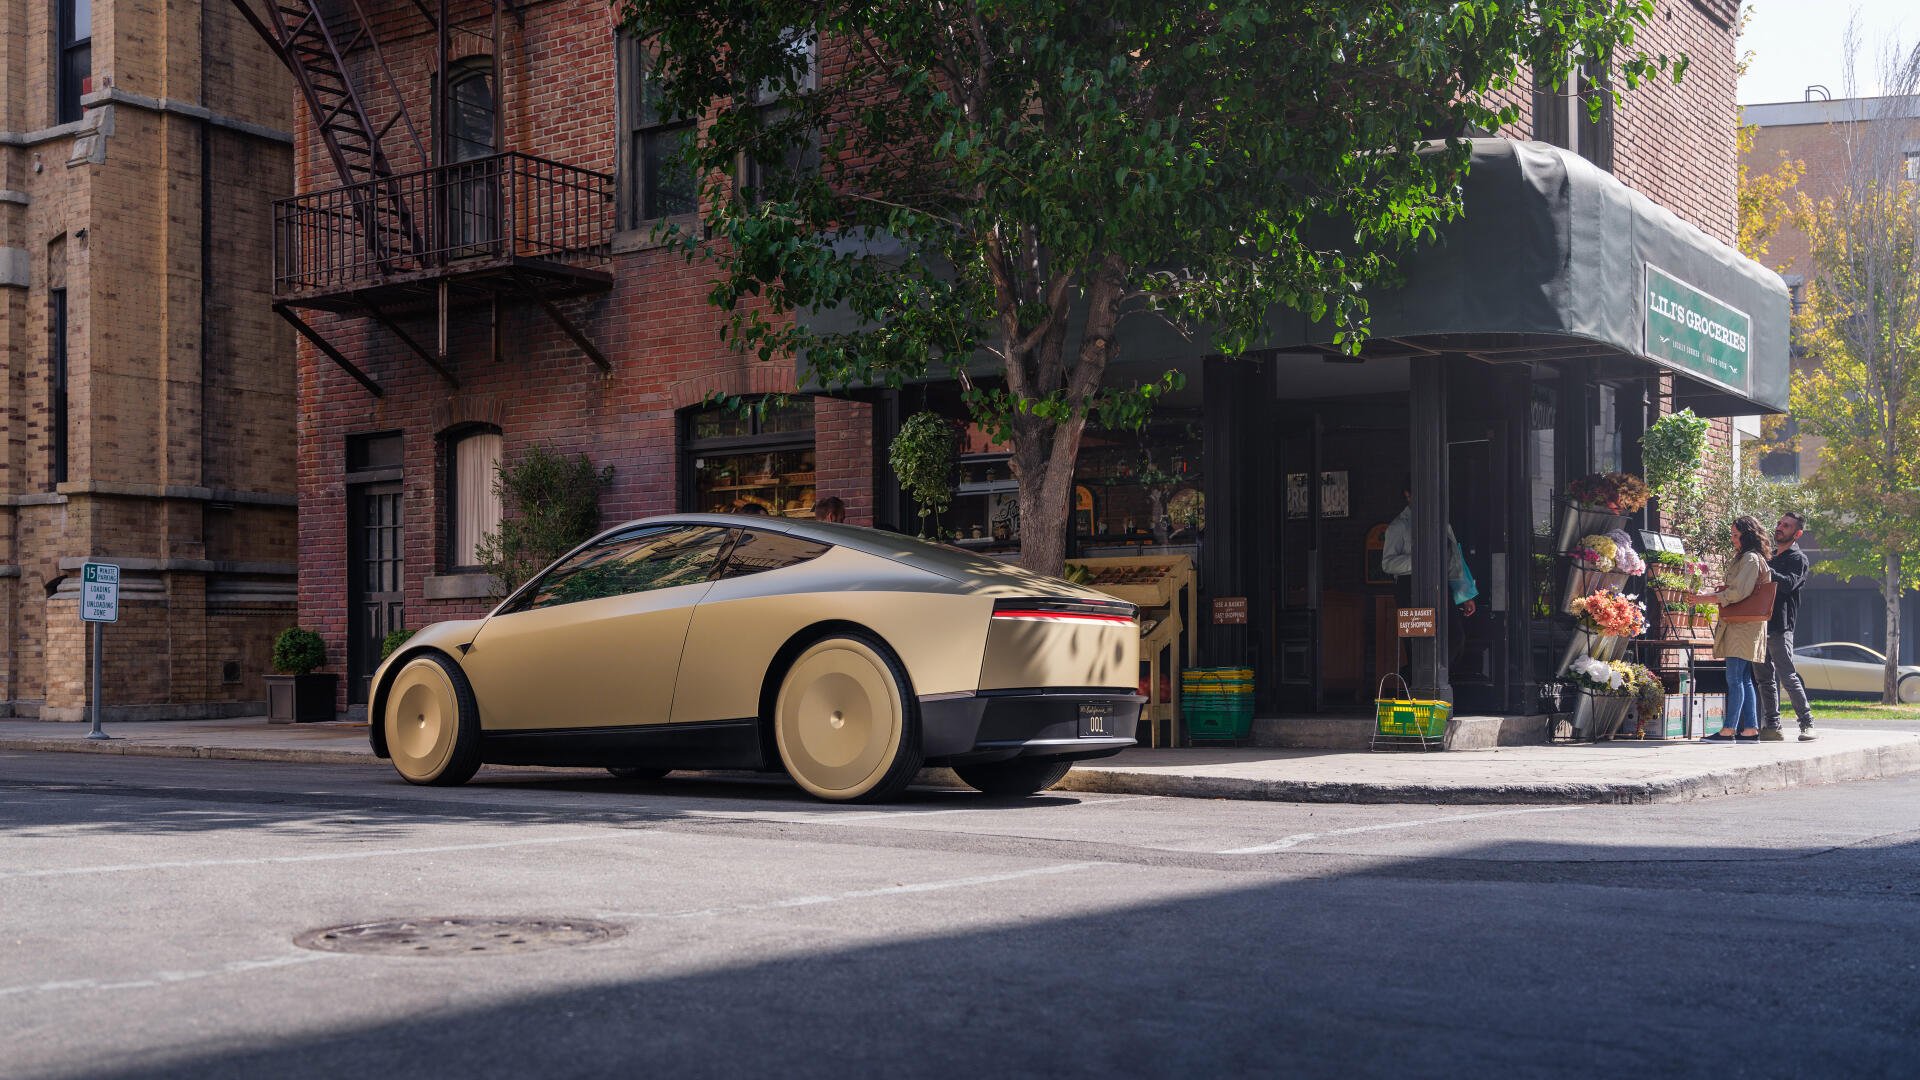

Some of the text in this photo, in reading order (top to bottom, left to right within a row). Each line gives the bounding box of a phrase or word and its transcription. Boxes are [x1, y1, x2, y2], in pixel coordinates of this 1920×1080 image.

[1650, 291, 1746, 352] LILI'S GROCERIES
[86, 567, 96, 579] 15
[97, 574, 117, 582] PARKING
[90, 585, 111, 594] LOADING
[95, 593, 106, 601] AND
[86, 601, 114, 609] UNLOADING
[93, 609, 106, 617] ZONE
[1090, 716, 1104, 732] 001
